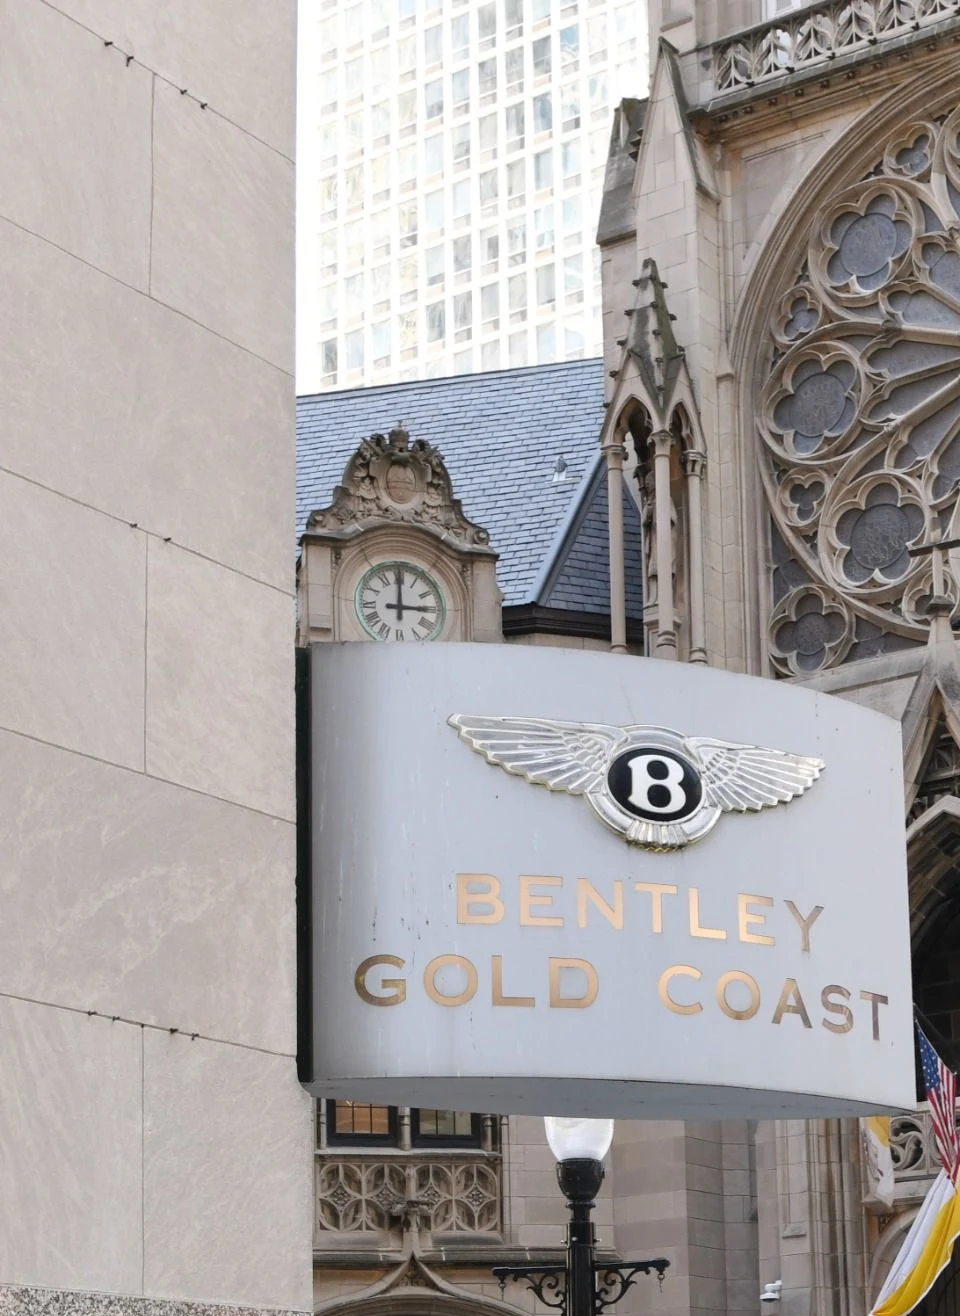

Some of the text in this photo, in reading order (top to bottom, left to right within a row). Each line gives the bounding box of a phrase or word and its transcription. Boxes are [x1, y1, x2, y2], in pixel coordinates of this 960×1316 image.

[627, 754, 686, 814] B
[455, 873, 825, 952] BENTLEY
[354, 954, 889, 1041] GOLD COAST
